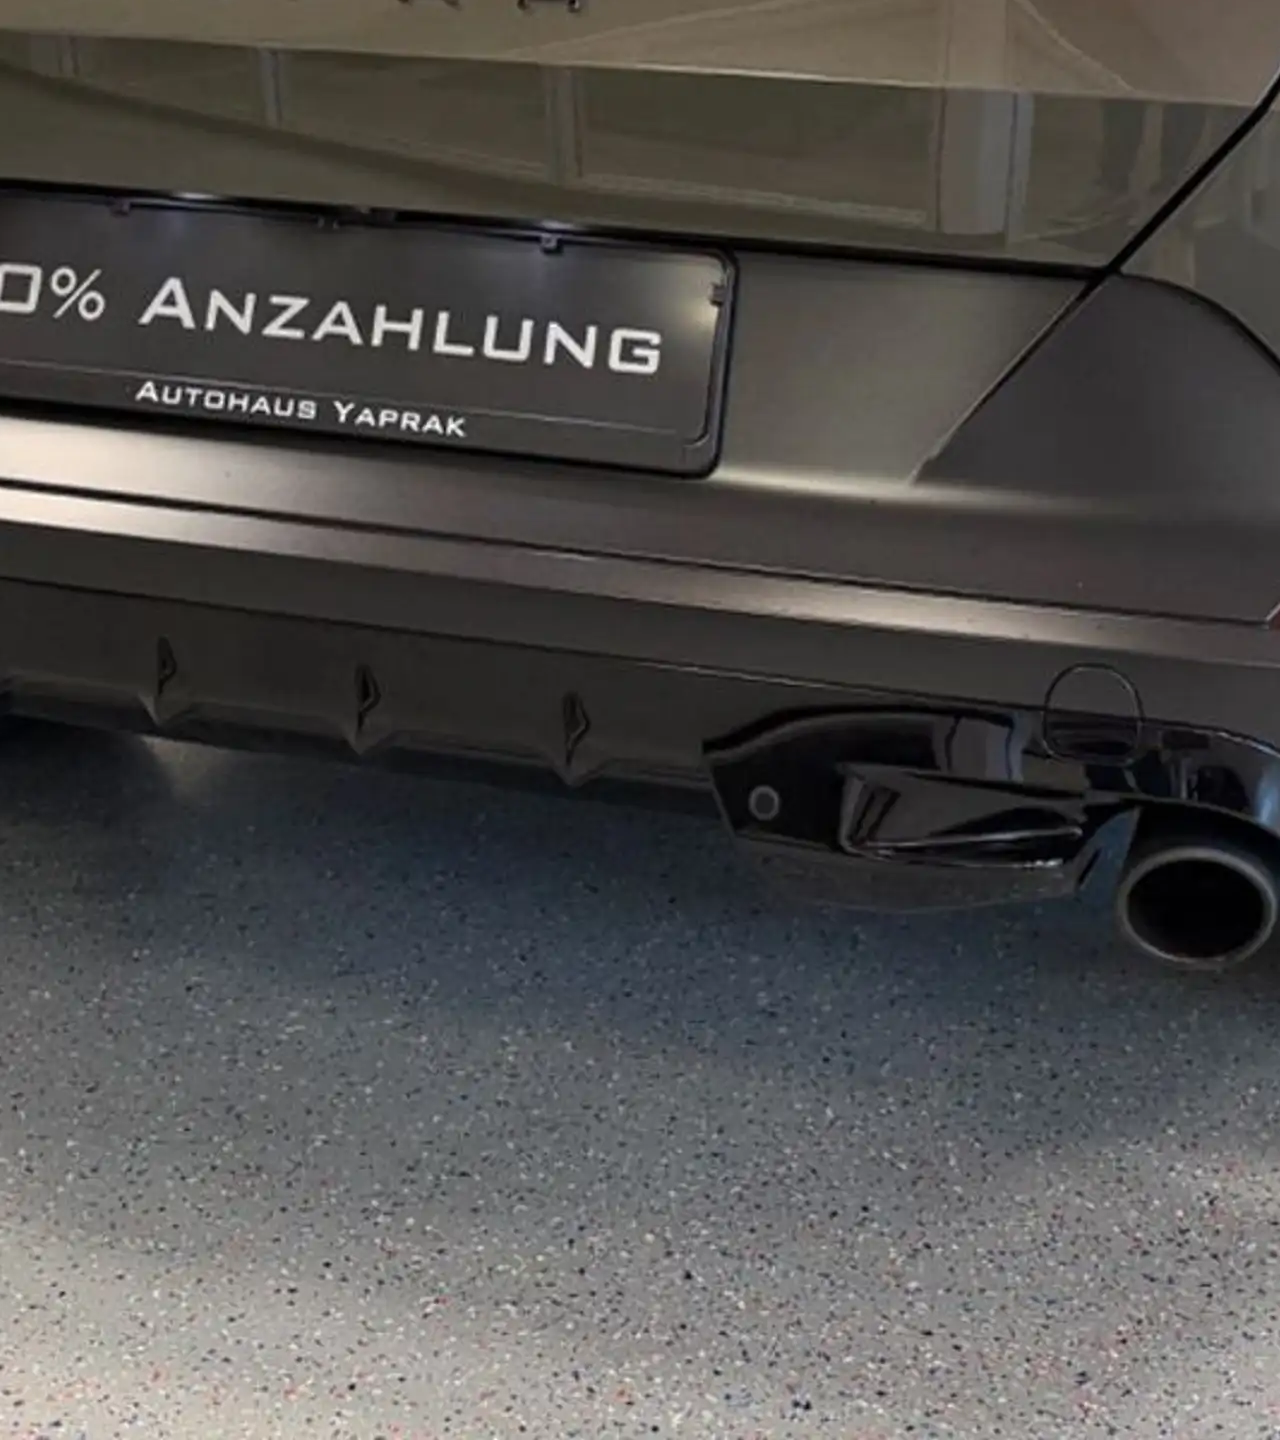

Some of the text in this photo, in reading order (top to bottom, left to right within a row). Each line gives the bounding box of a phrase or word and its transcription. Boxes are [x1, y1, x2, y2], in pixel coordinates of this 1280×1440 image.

[138, 277, 662, 375] ANZAHLUNG
[136, 381, 467, 438] AUTOHAUS YAPRAK
